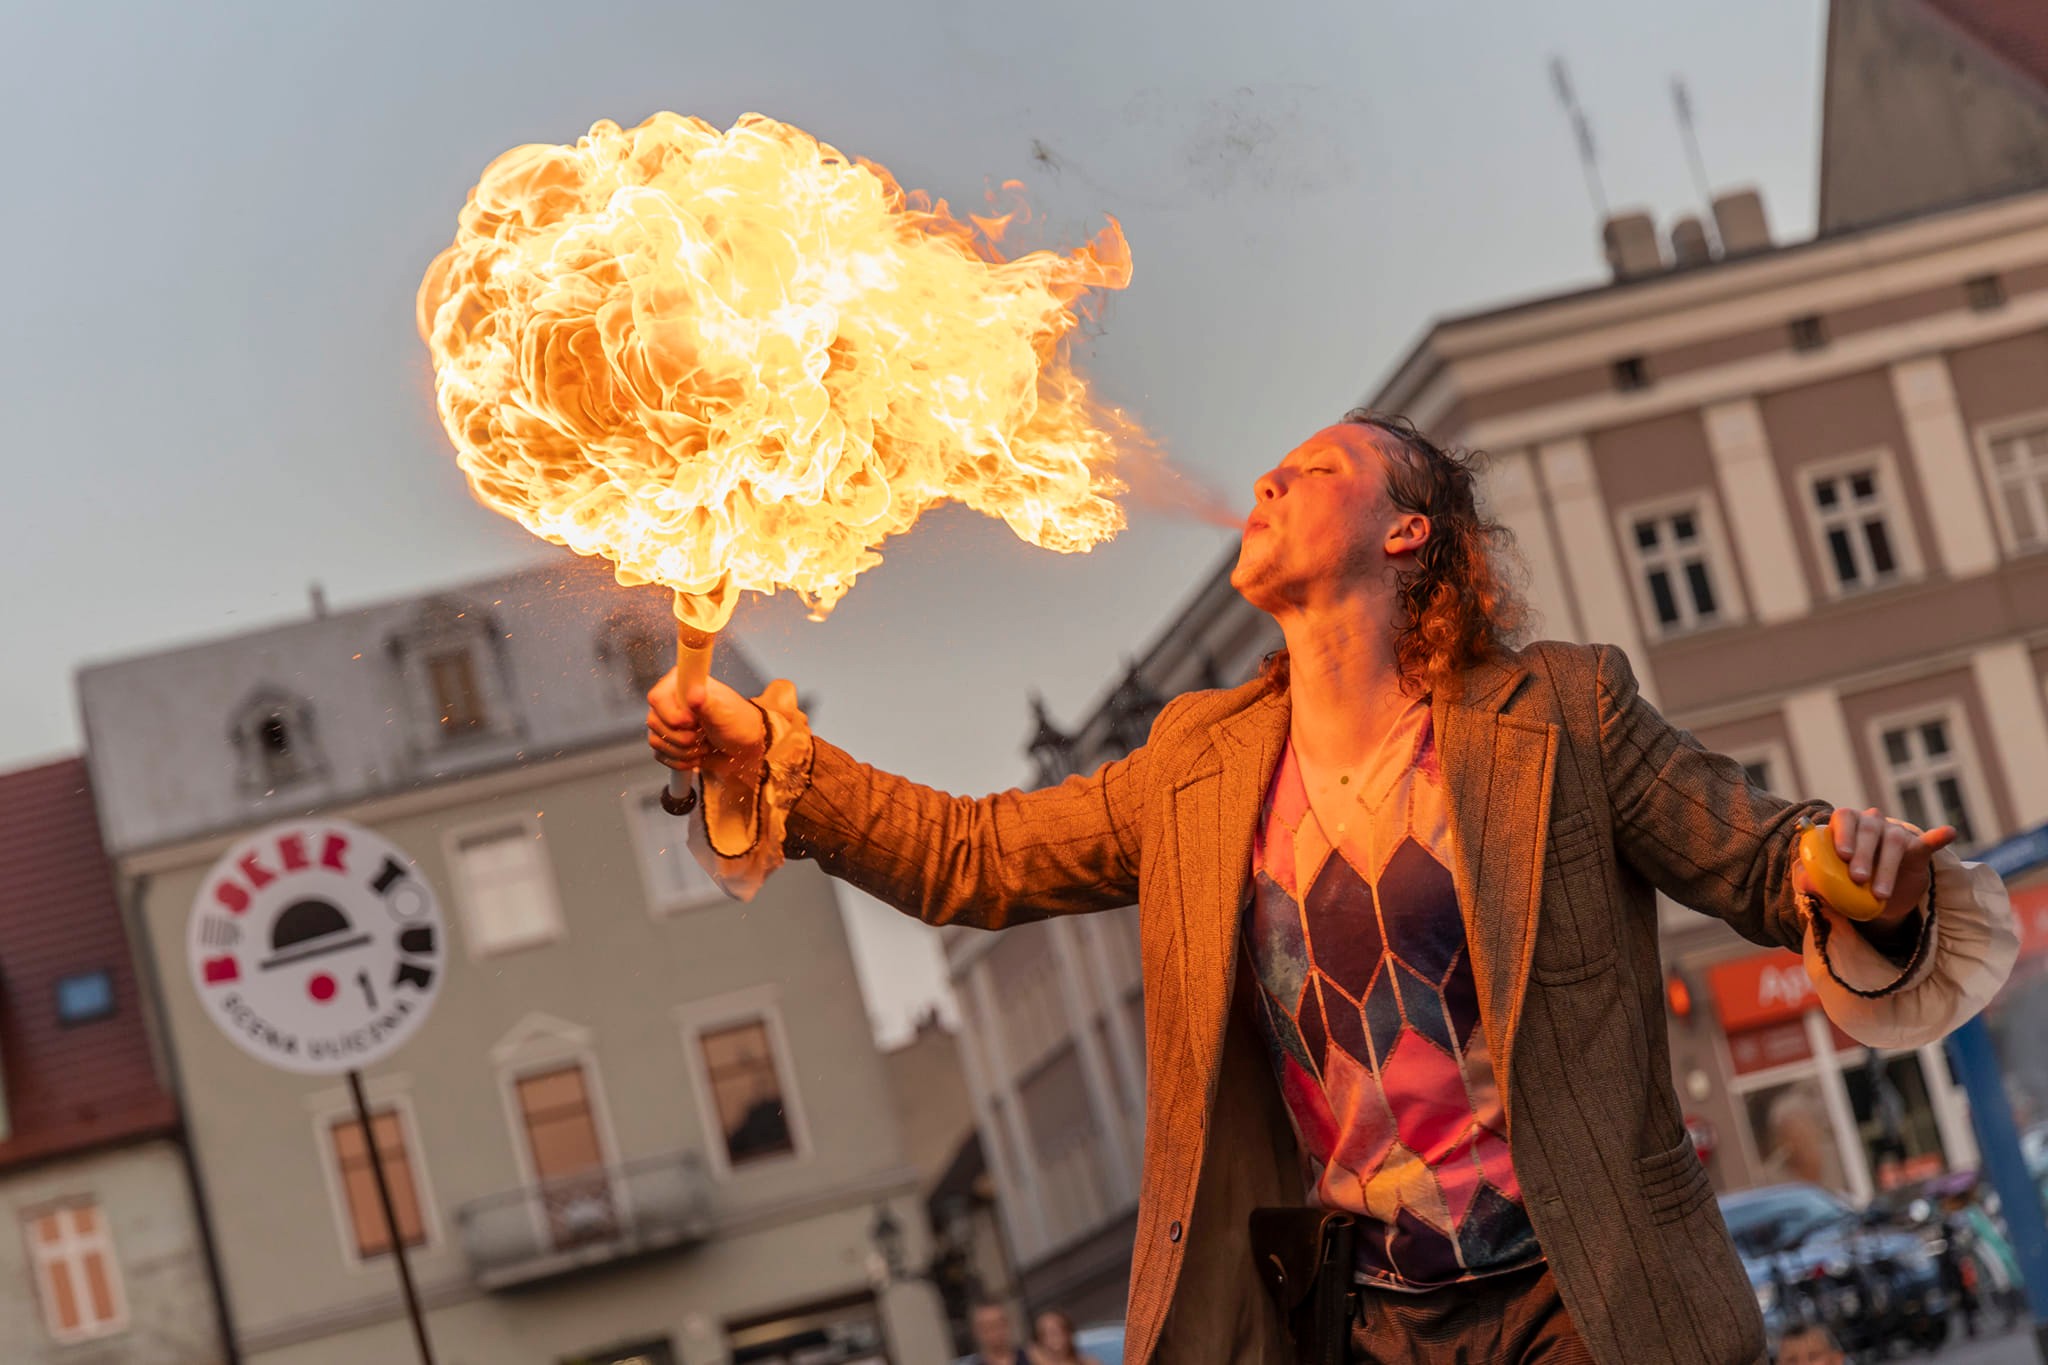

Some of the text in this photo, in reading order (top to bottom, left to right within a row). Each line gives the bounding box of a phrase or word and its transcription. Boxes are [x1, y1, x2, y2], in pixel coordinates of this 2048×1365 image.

[202, 832, 435, 992] BUSKER TOUR
[222, 993, 412, 1058] SCENA ULICZNA
